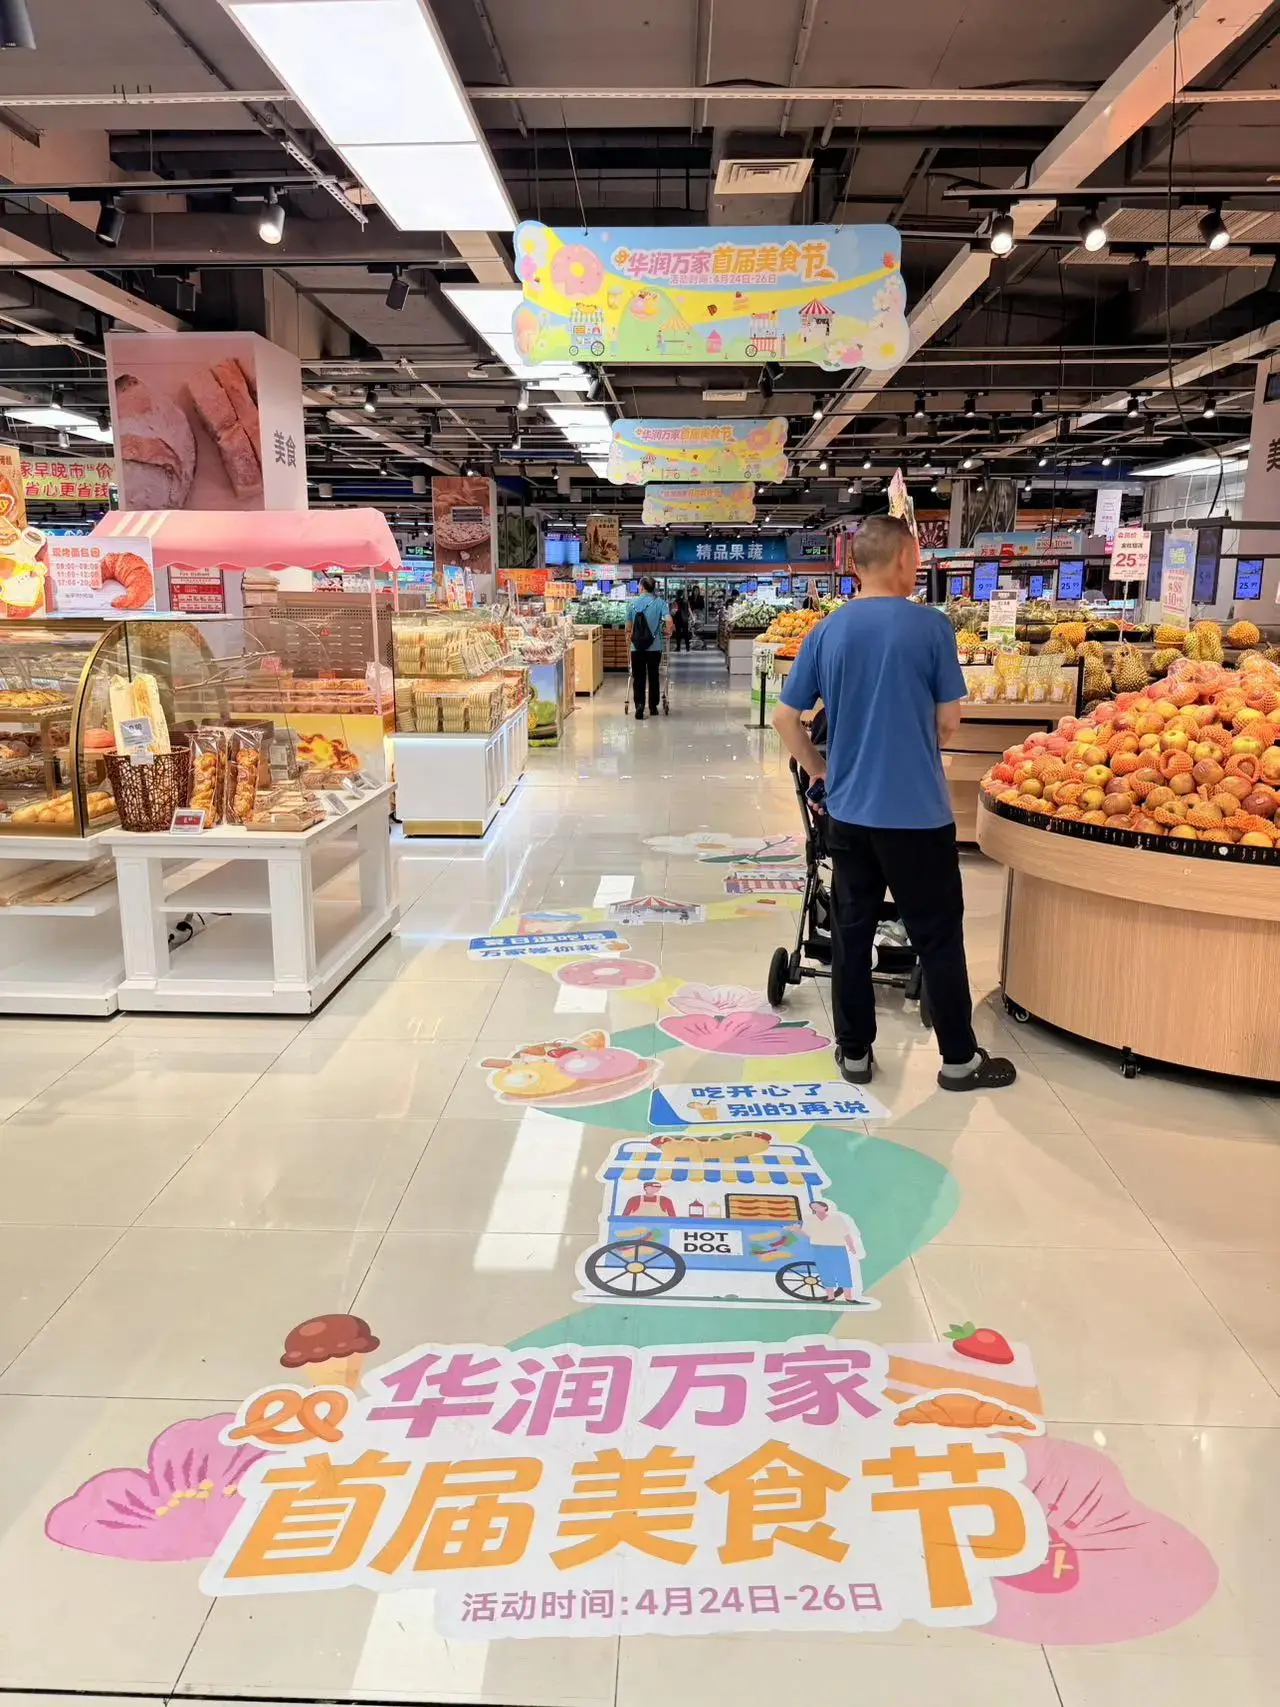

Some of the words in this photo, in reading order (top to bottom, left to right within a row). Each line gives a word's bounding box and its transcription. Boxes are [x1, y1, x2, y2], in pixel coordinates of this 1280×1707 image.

[627, 242, 828, 279] 华润万家首届美食节
[273, 429, 297, 468] 美食
[25, 481, 108, 498] 省心更省钱
[696, 542, 764, 561] 精品果蔬
[480, 944, 600, 957] 万家等你来
[691, 1083, 822, 1099] 吃开心了
[727, 1100, 870, 1117] 别的再说
[684, 1231, 729, 1242] HOT
[684, 1243, 731, 1253] DOG
[365, 1344, 882, 1439] 华润万家
[224, 1438, 1026, 1609] 首届美食节
[461, 1583, 883, 1622] 活动时间:4月24日-26日
